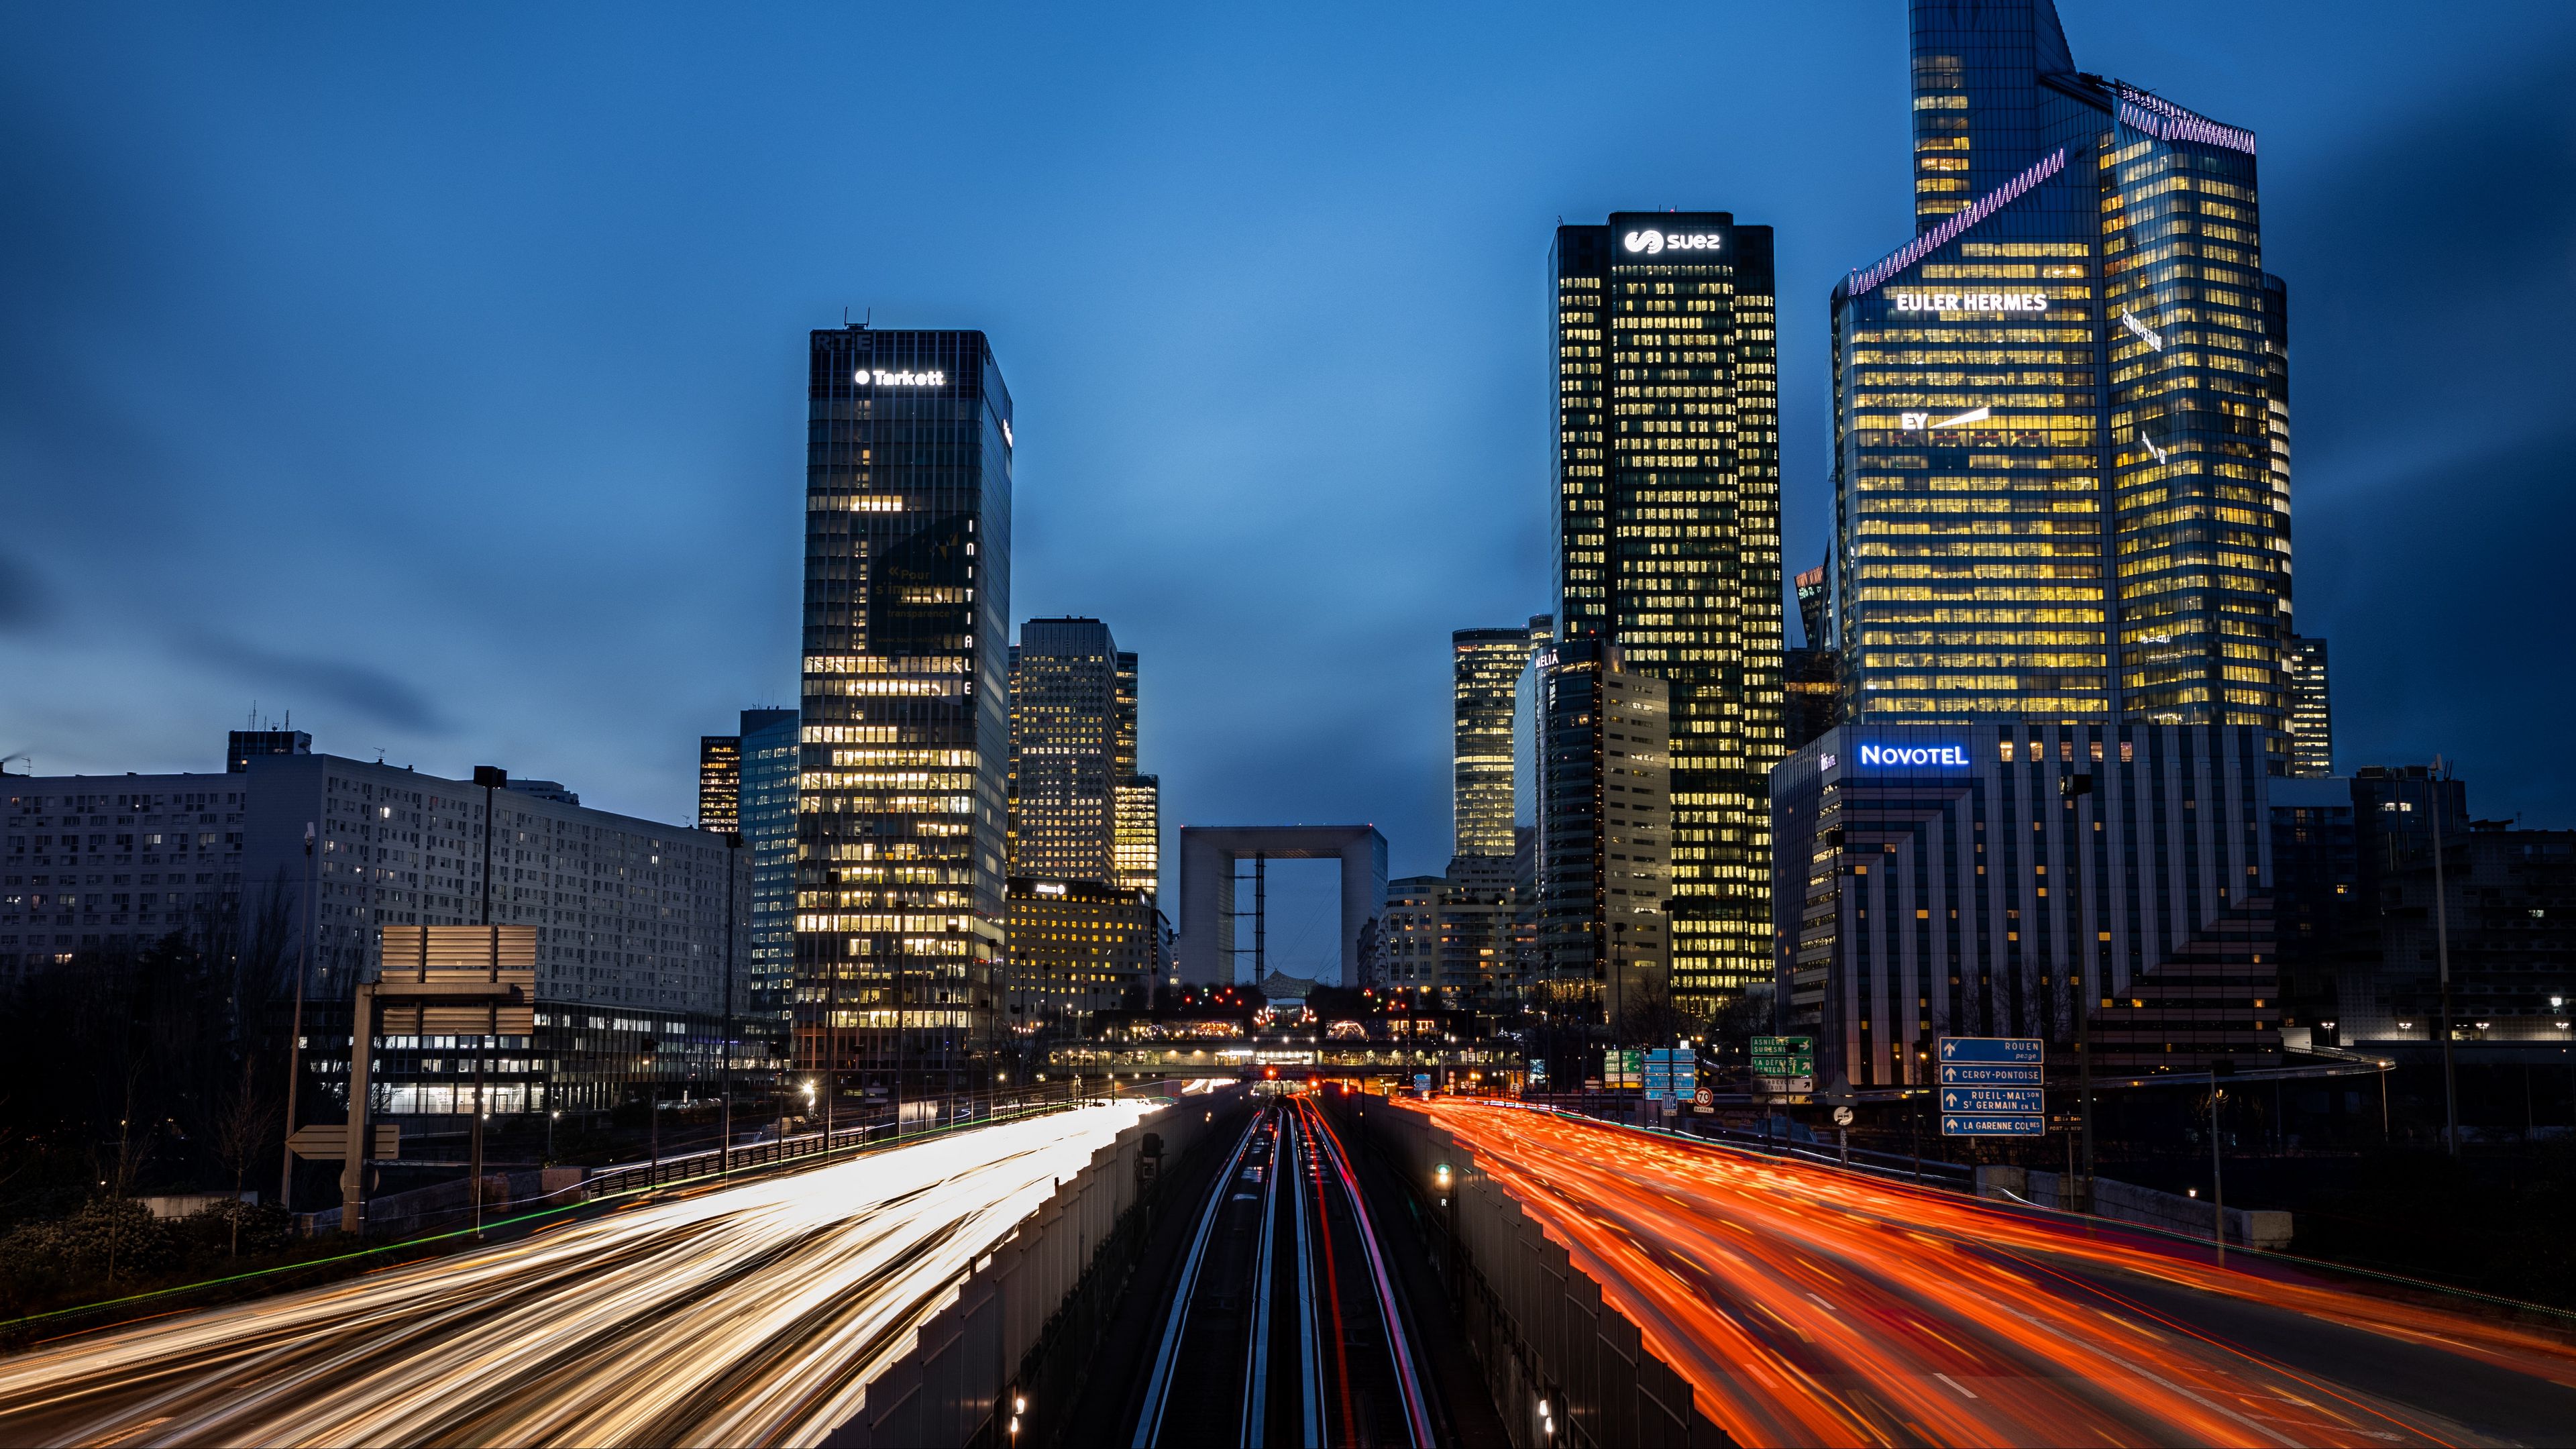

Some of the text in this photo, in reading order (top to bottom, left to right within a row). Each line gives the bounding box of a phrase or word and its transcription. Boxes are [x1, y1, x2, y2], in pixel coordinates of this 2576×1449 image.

[1667, 234, 1720, 249] suez
[1897, 294, 2047, 311] EULER HERMES
[814, 334, 871, 351] RTE
[873, 370, 944, 386] Tarkett
[1902, 413, 1928, 429] EY
[902, 569, 930, 580] Pour
[888, 610, 950, 619] transparence
[1862, 745, 1969, 765] NOVOTEL
[2004, 1042, 2039, 1051] ROUEN
[1962, 1071, 2039, 1079] CERGY-PONTOISE
[1699, 1093, 1709, 1101] 70
[1976, 1102, 2017, 1110] GERMAIN
[1964, 1122, 1974, 1130] LA
[1976, 1122, 2012, 1130] GARENNE
[1441, 1198, 1447, 1207] R
